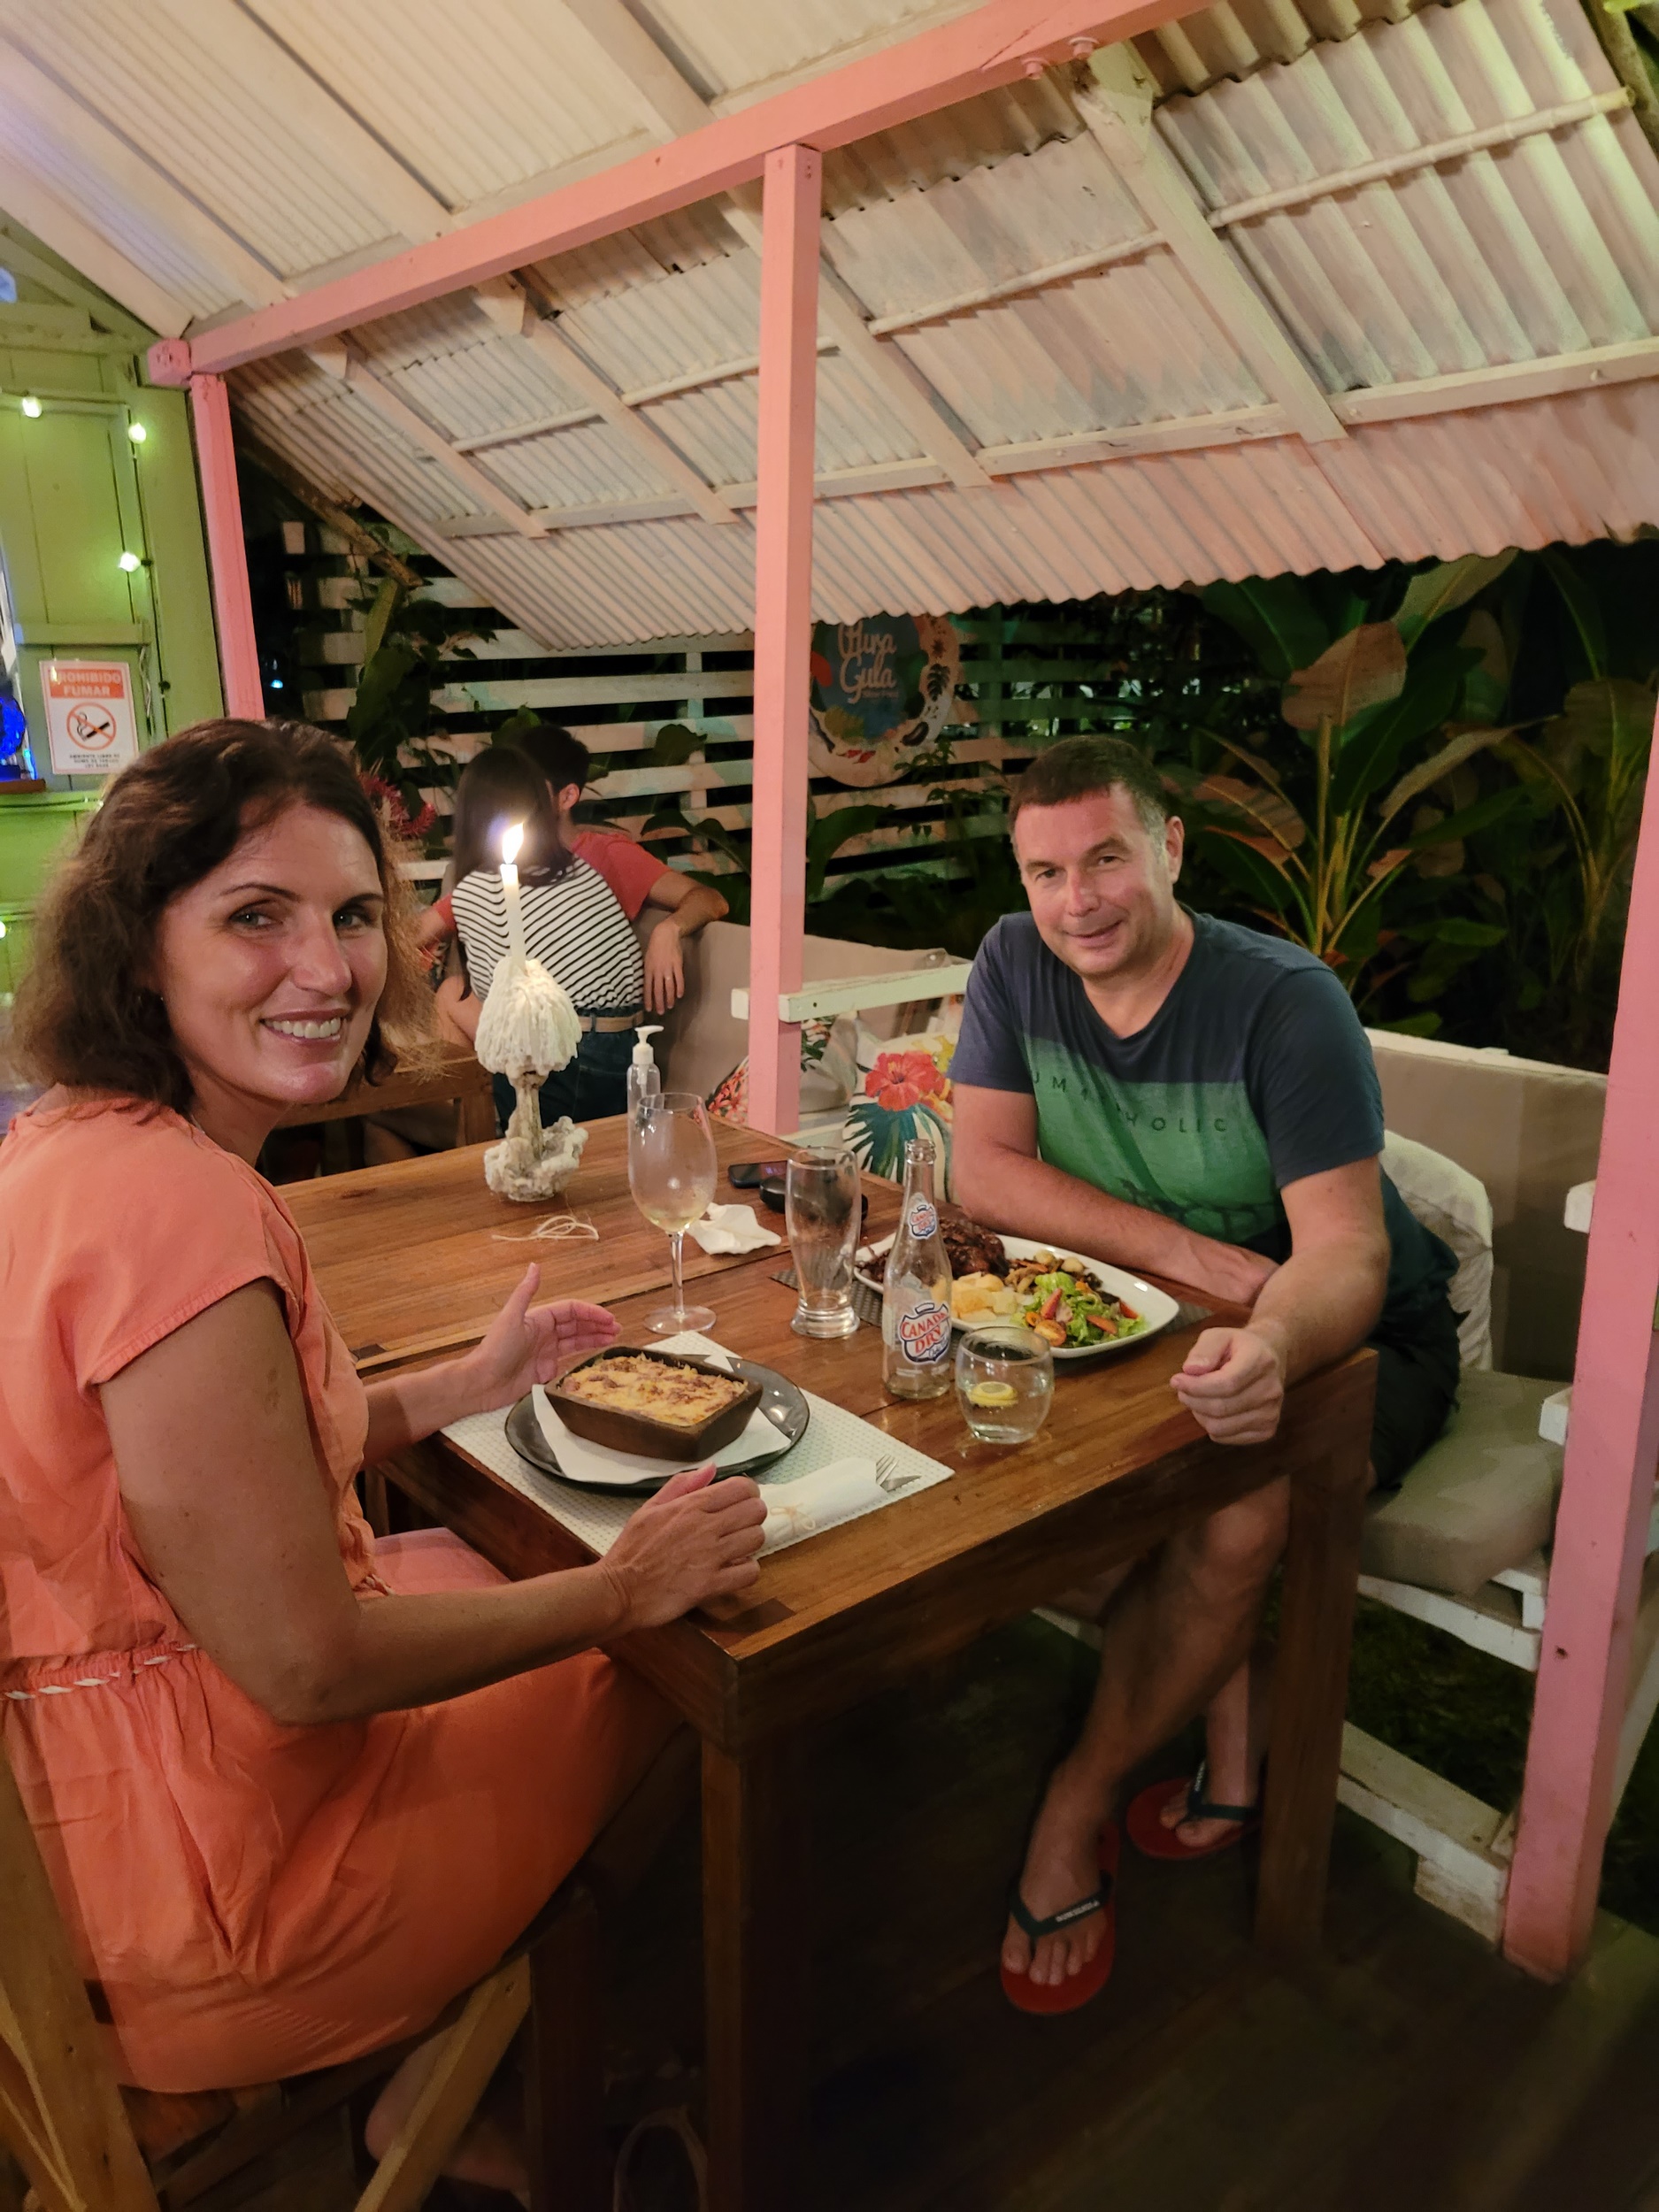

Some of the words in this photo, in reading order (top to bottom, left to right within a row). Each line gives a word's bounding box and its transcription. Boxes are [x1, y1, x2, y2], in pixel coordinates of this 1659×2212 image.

[52, 672, 121, 684] ROHIBIDO
[64, 686, 111, 696] FUMAR
[840, 653, 897, 704] Gula
[901, 1312, 946, 1339] CANADA
[915, 1325, 941, 1354] DRY
